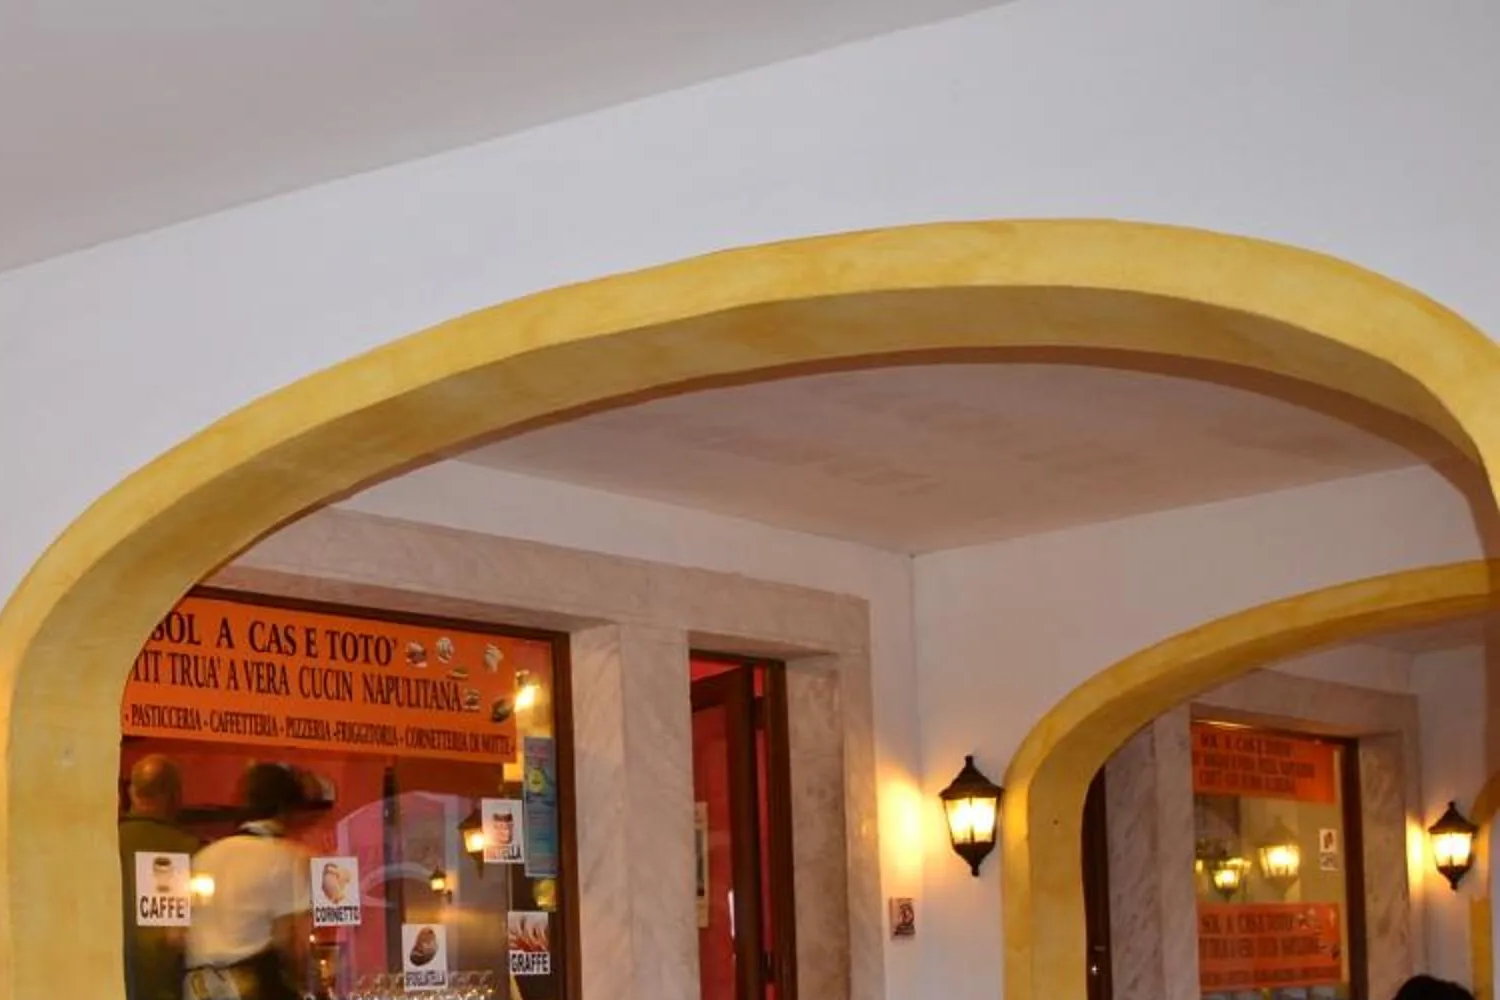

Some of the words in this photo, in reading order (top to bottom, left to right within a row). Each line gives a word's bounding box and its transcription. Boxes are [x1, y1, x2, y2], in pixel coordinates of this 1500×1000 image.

[216, 617, 234, 649] A
[249, 620, 297, 657] CAS
[305, 627, 318, 658] E
[227, 660, 239, 691] A
[244, 661, 290, 696] VERA
[298, 666, 353, 703] CUCIN
[362, 672, 463, 713] NAPULITANA
[131, 704, 202, 730] PASTICCERIA
[512, 953, 548, 972] GRAFFE
